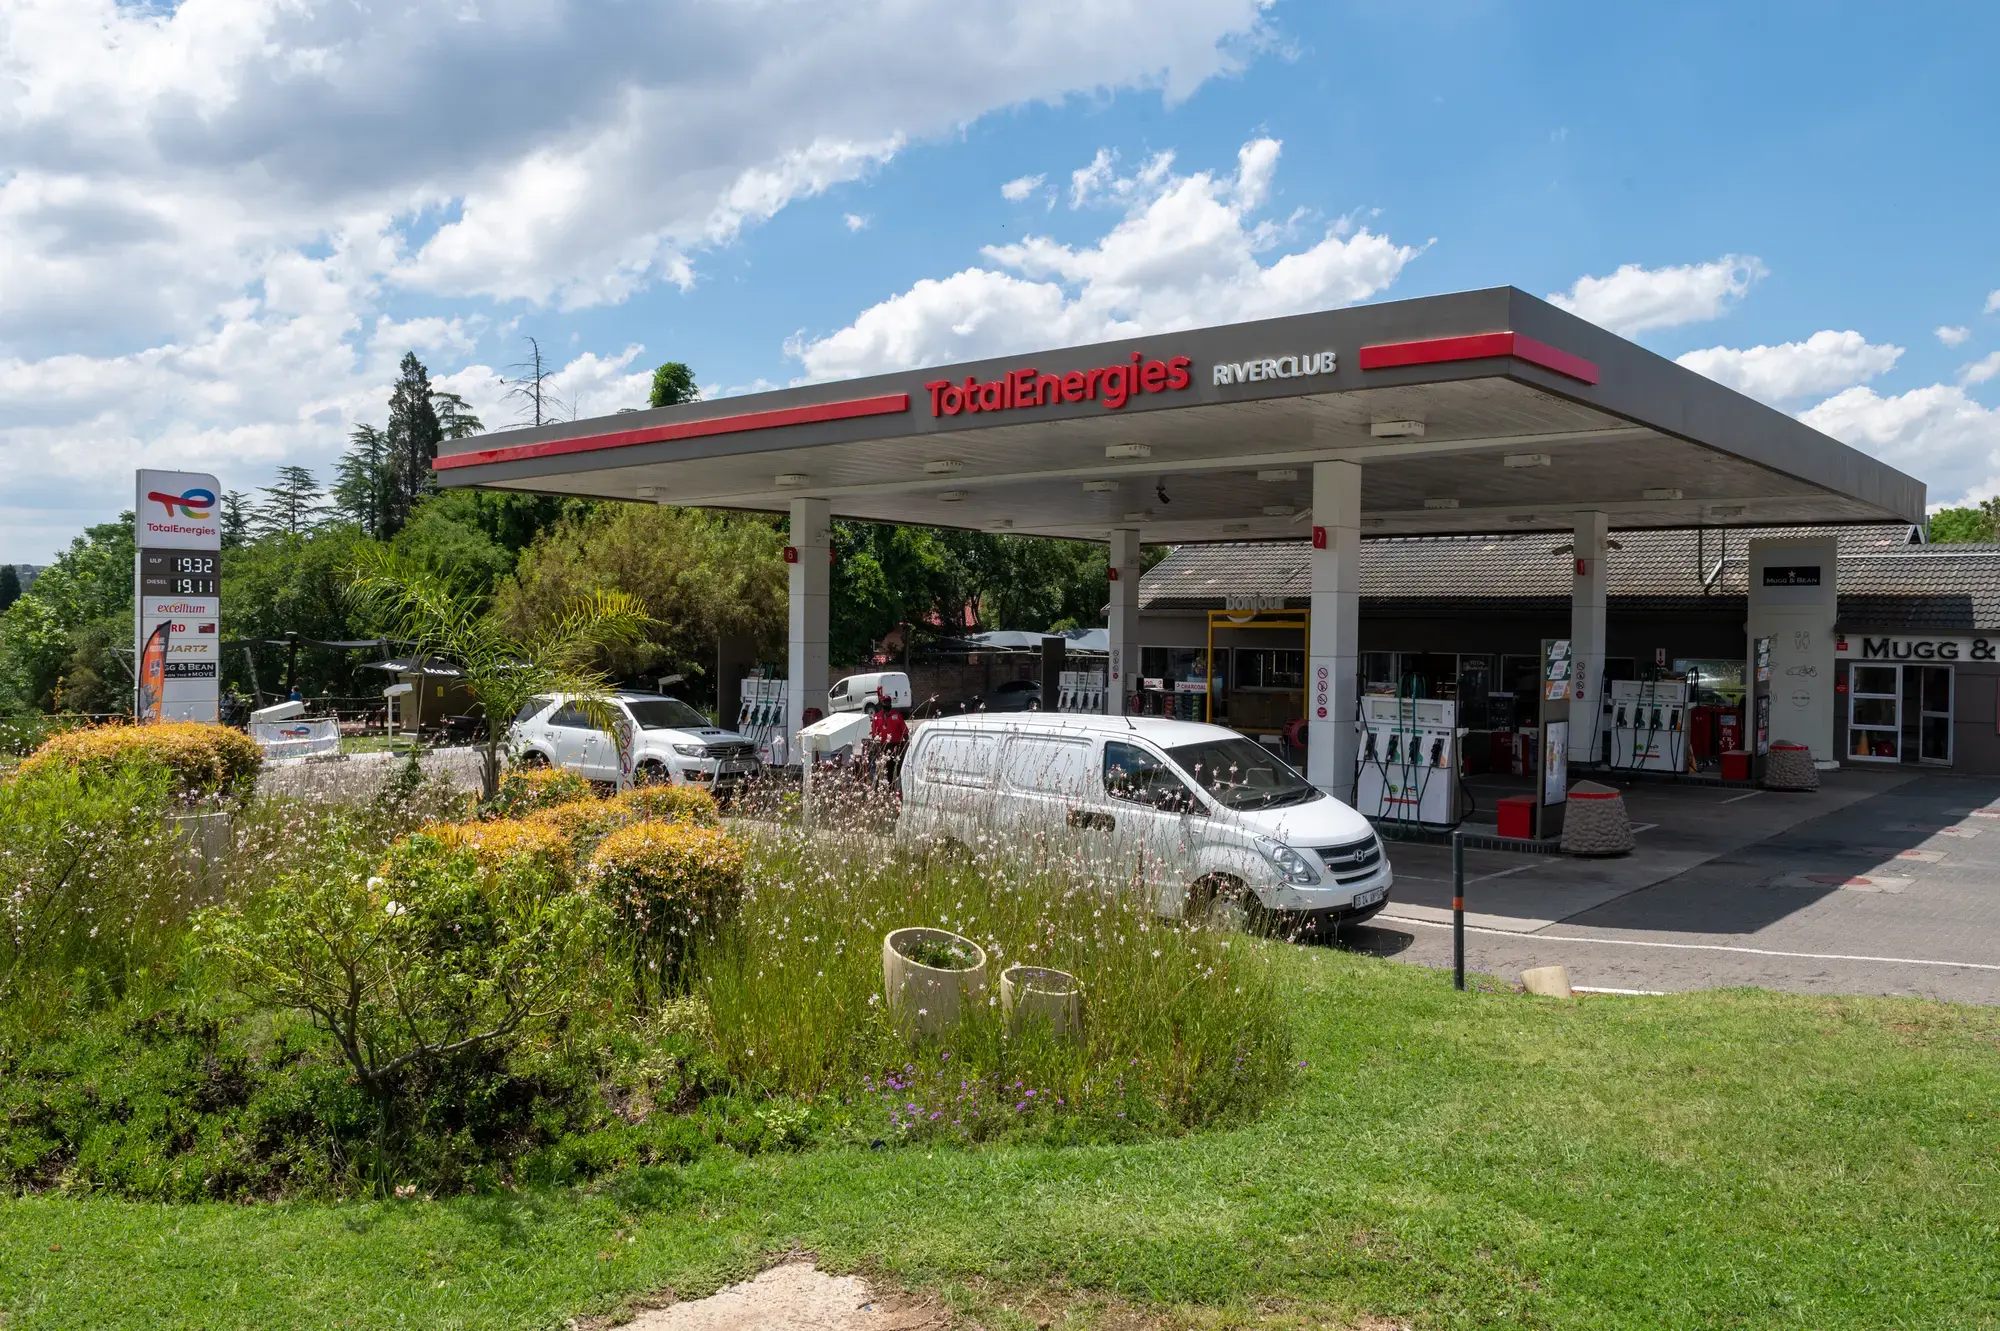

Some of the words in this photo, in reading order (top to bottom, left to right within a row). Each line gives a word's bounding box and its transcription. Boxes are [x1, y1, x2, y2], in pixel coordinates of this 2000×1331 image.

[1213, 351, 1336, 386] RIVERCLUB
[924, 351, 1192, 417] TotalEnergies
[147, 523, 216, 536] TotalEnergies
[787, 550, 794, 560] 6
[178, 558, 213, 573] 19.32
[177, 578, 213, 593] 19.11
[157, 603, 206, 613] excellium
[1225, 595, 1285, 612] bonjour
[167, 645, 208, 653] UARTZ
[1862, 638, 1960, 660] MUGG
[1970, 638, 1996, 660] &
[178, 663, 186, 671] &
[187, 663, 214, 671] BEAN
